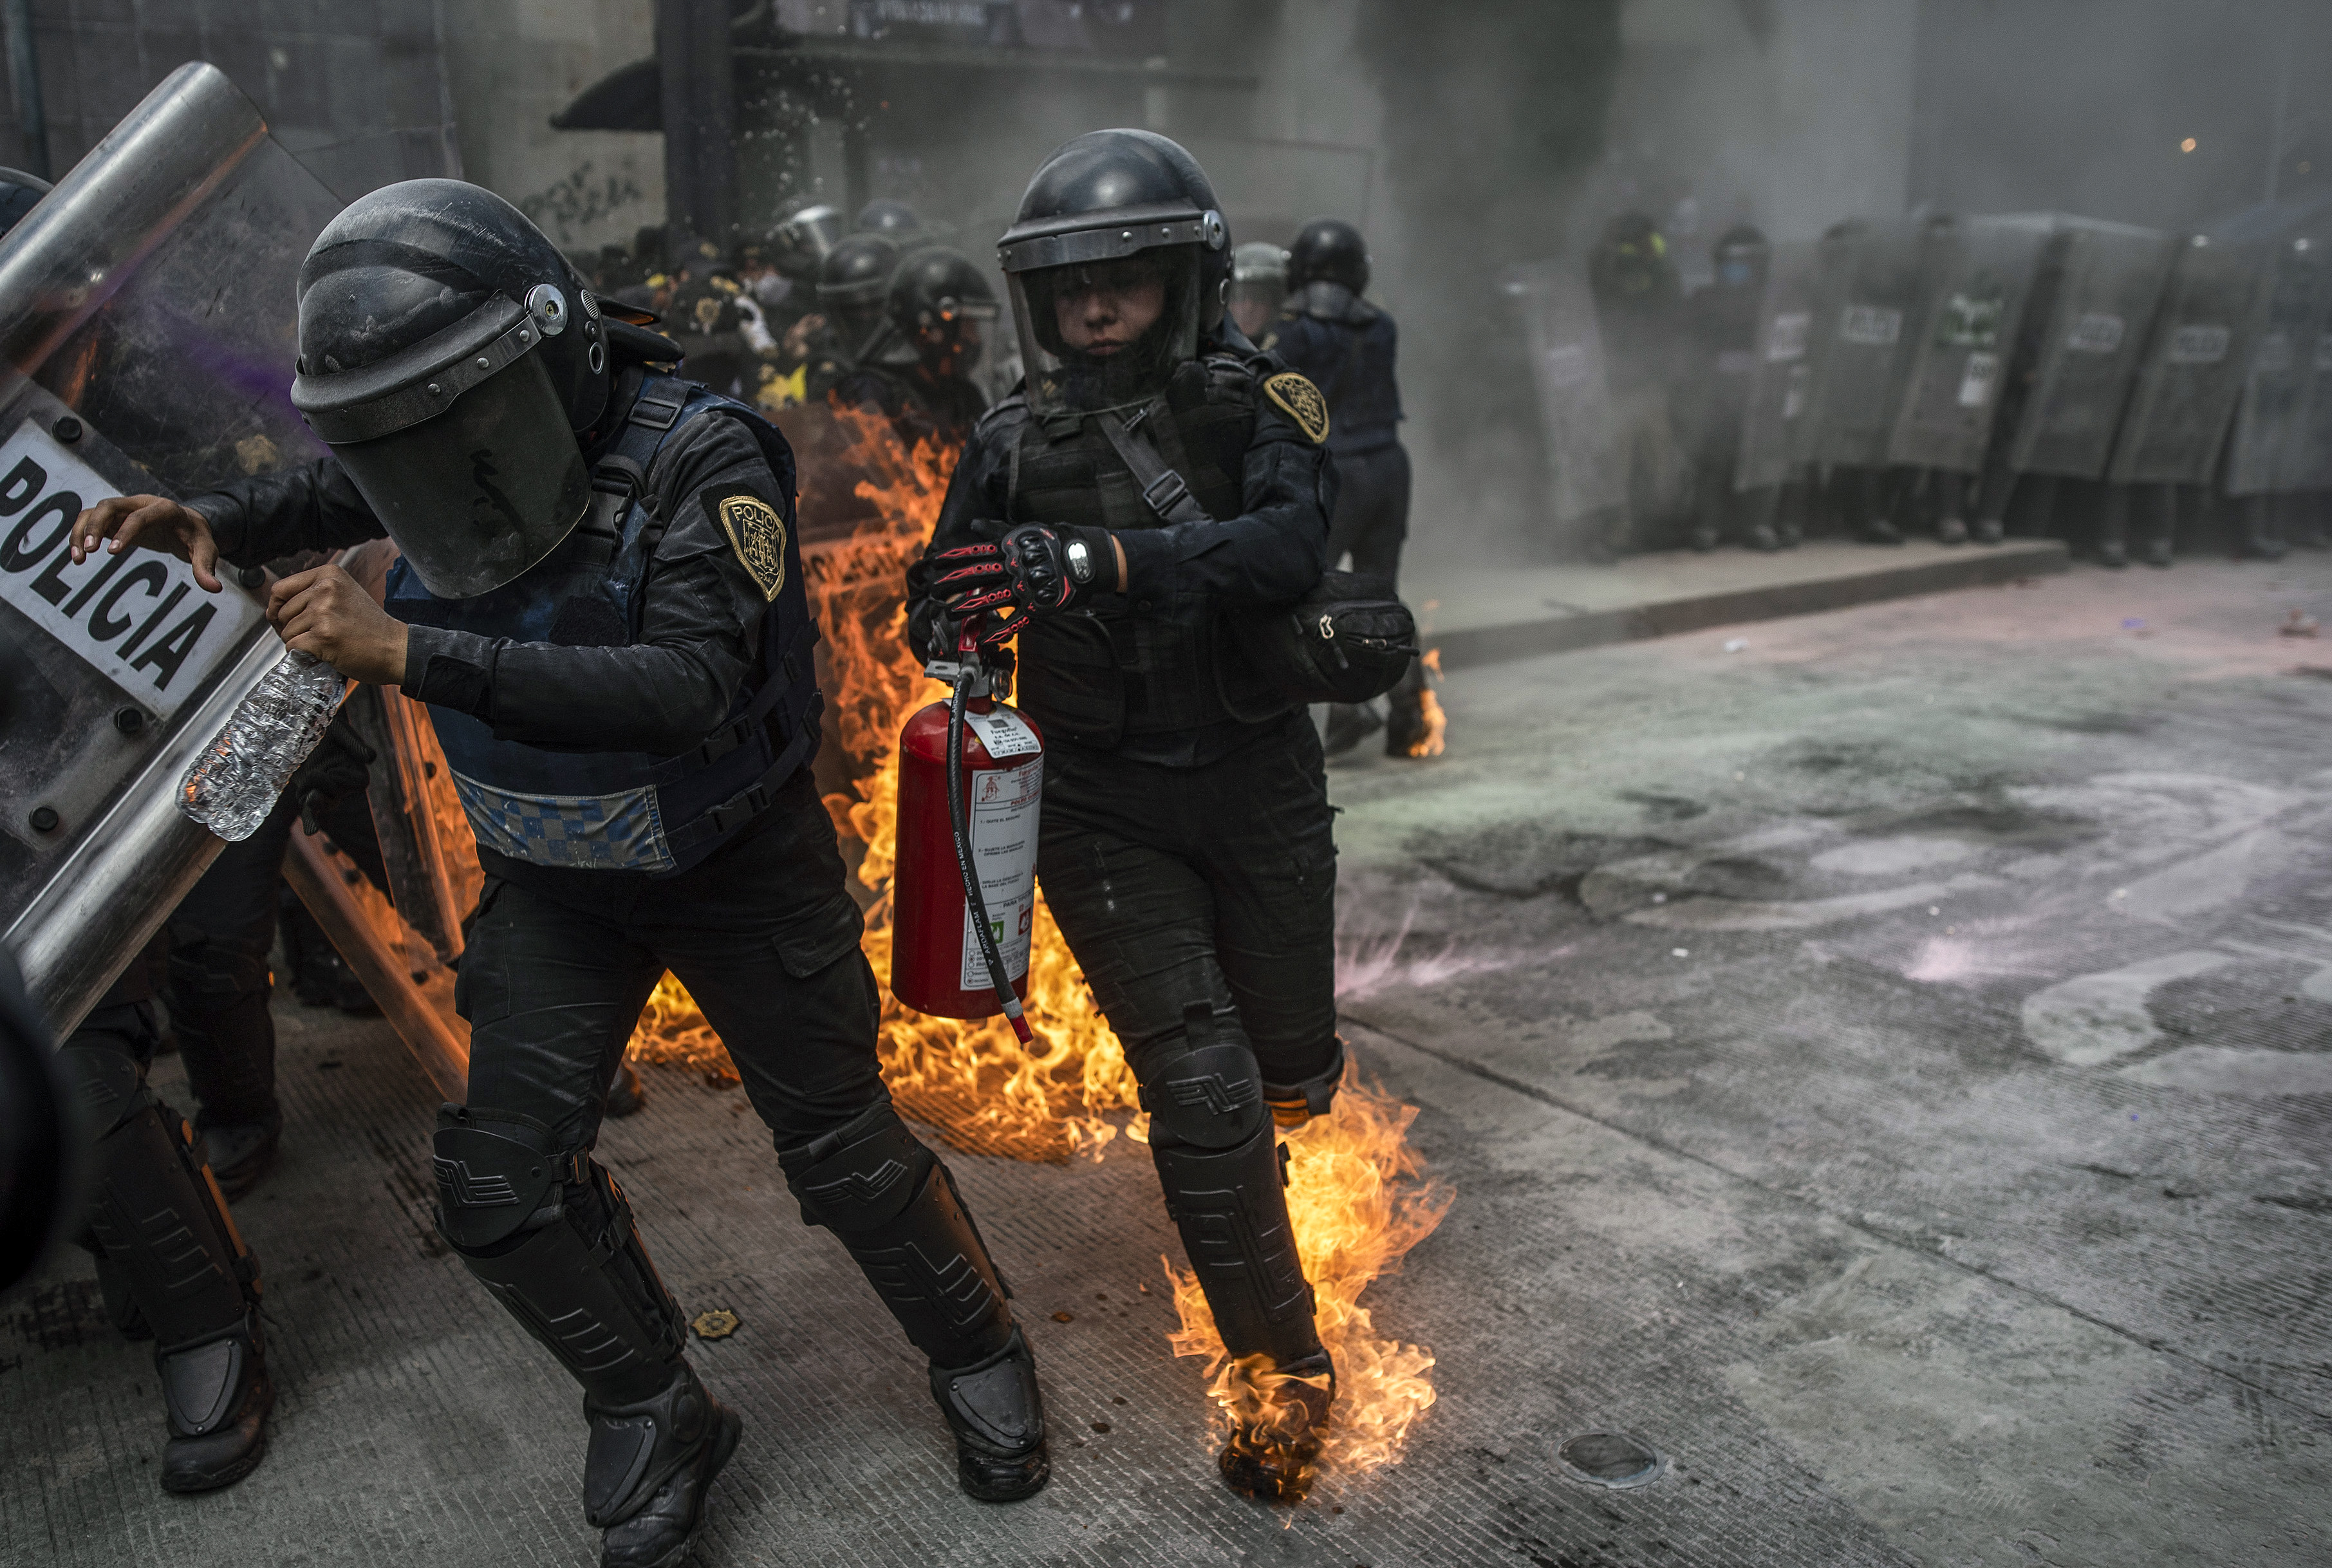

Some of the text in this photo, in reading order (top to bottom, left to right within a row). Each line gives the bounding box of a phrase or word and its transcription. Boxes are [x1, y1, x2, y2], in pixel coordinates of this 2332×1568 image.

[731, 505, 781, 543] POLICIA
[0, 455, 218, 692] POLICIA
[954, 831, 964, 859] MEXICO
[960, 860, 967, 870] EN
[963, 872, 973, 897] HECHO
